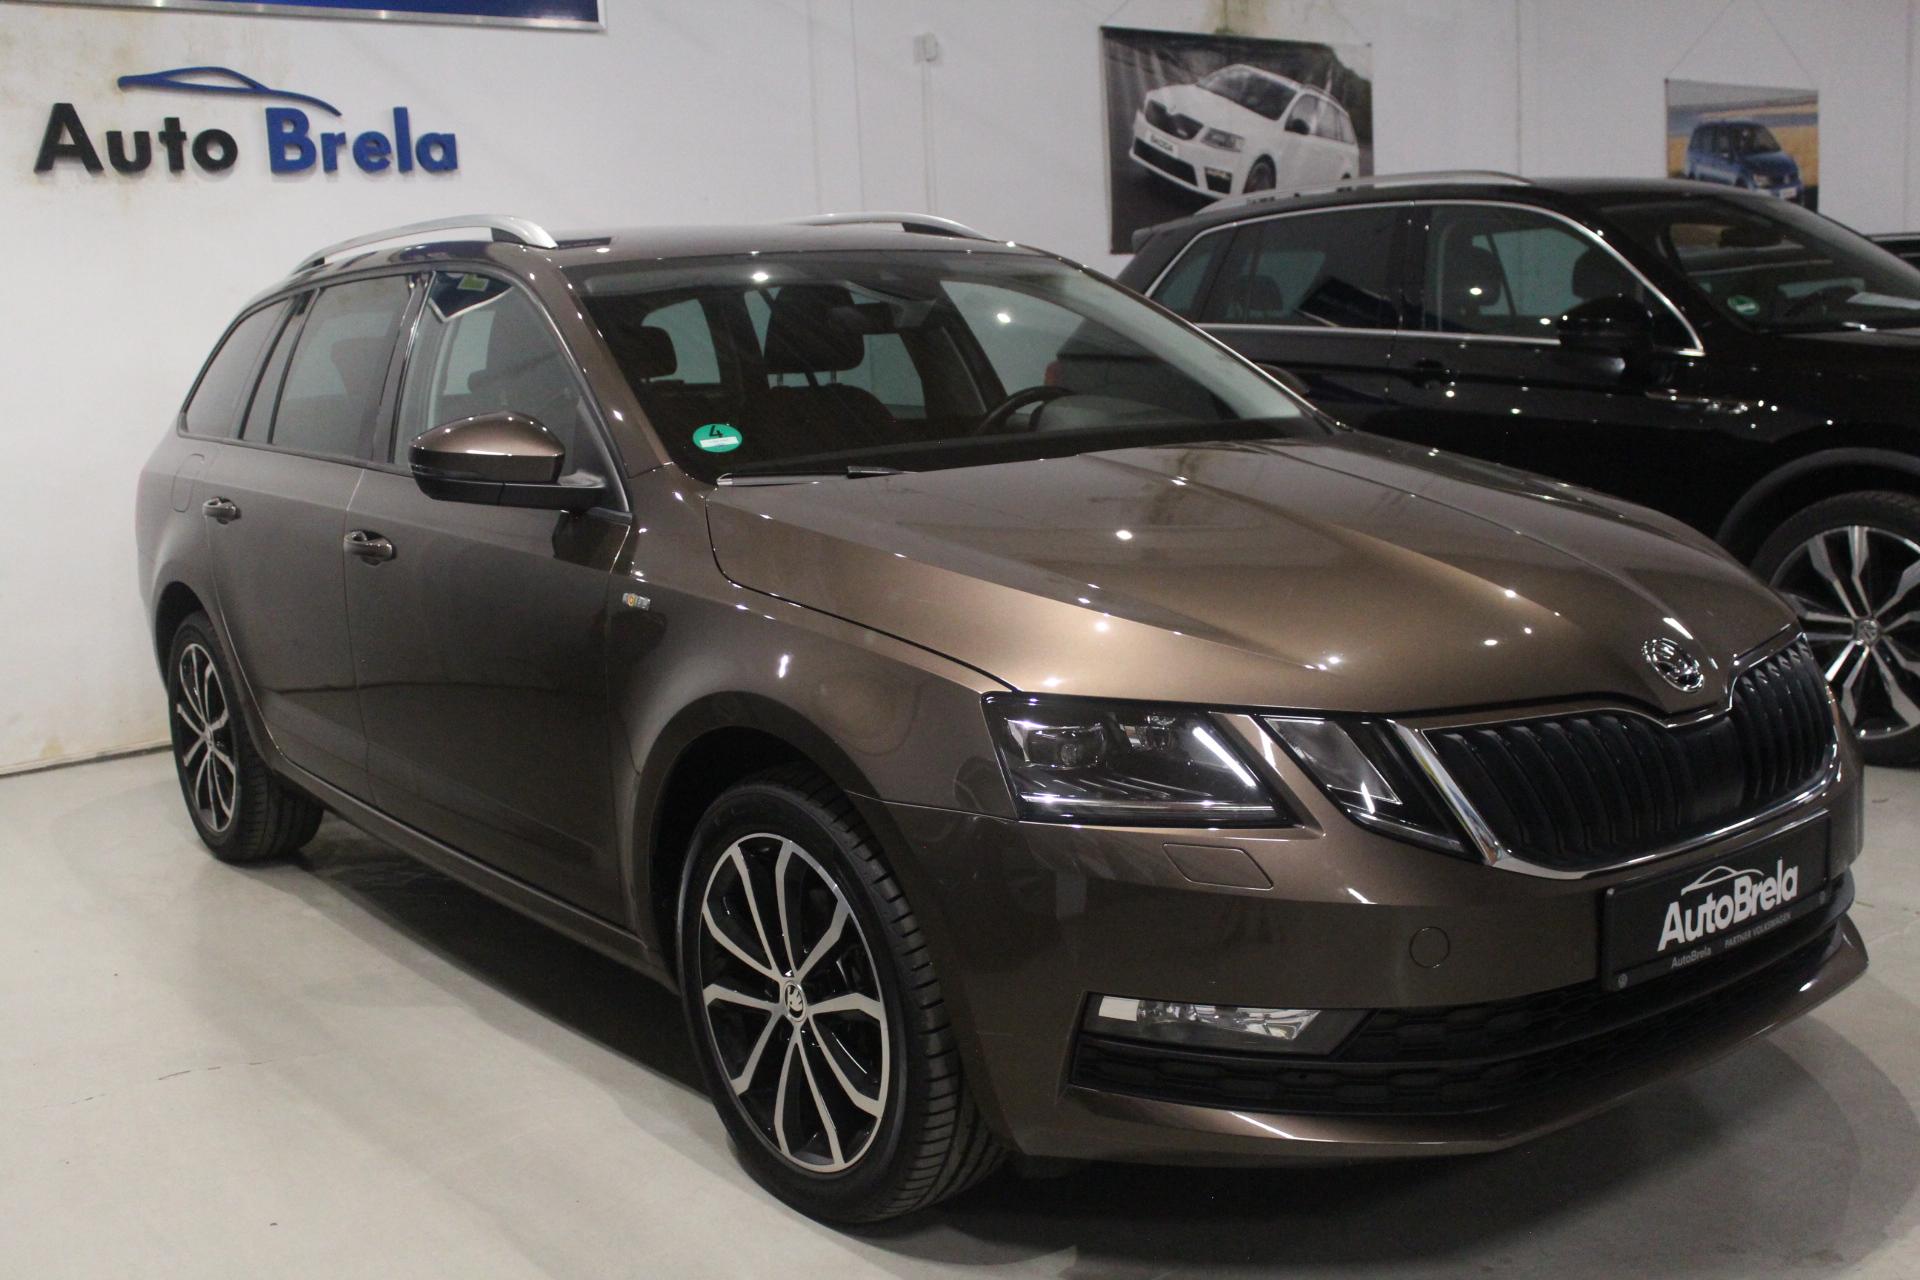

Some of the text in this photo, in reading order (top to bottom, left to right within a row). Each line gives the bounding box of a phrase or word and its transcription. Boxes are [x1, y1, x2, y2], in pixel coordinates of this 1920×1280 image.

[34, 102, 458, 174] Auto Brela
[709, 425, 724, 438] 4
[1657, 858, 1799, 951] AutoBrela
[1670, 945, 1712, 968] AutoBrela
